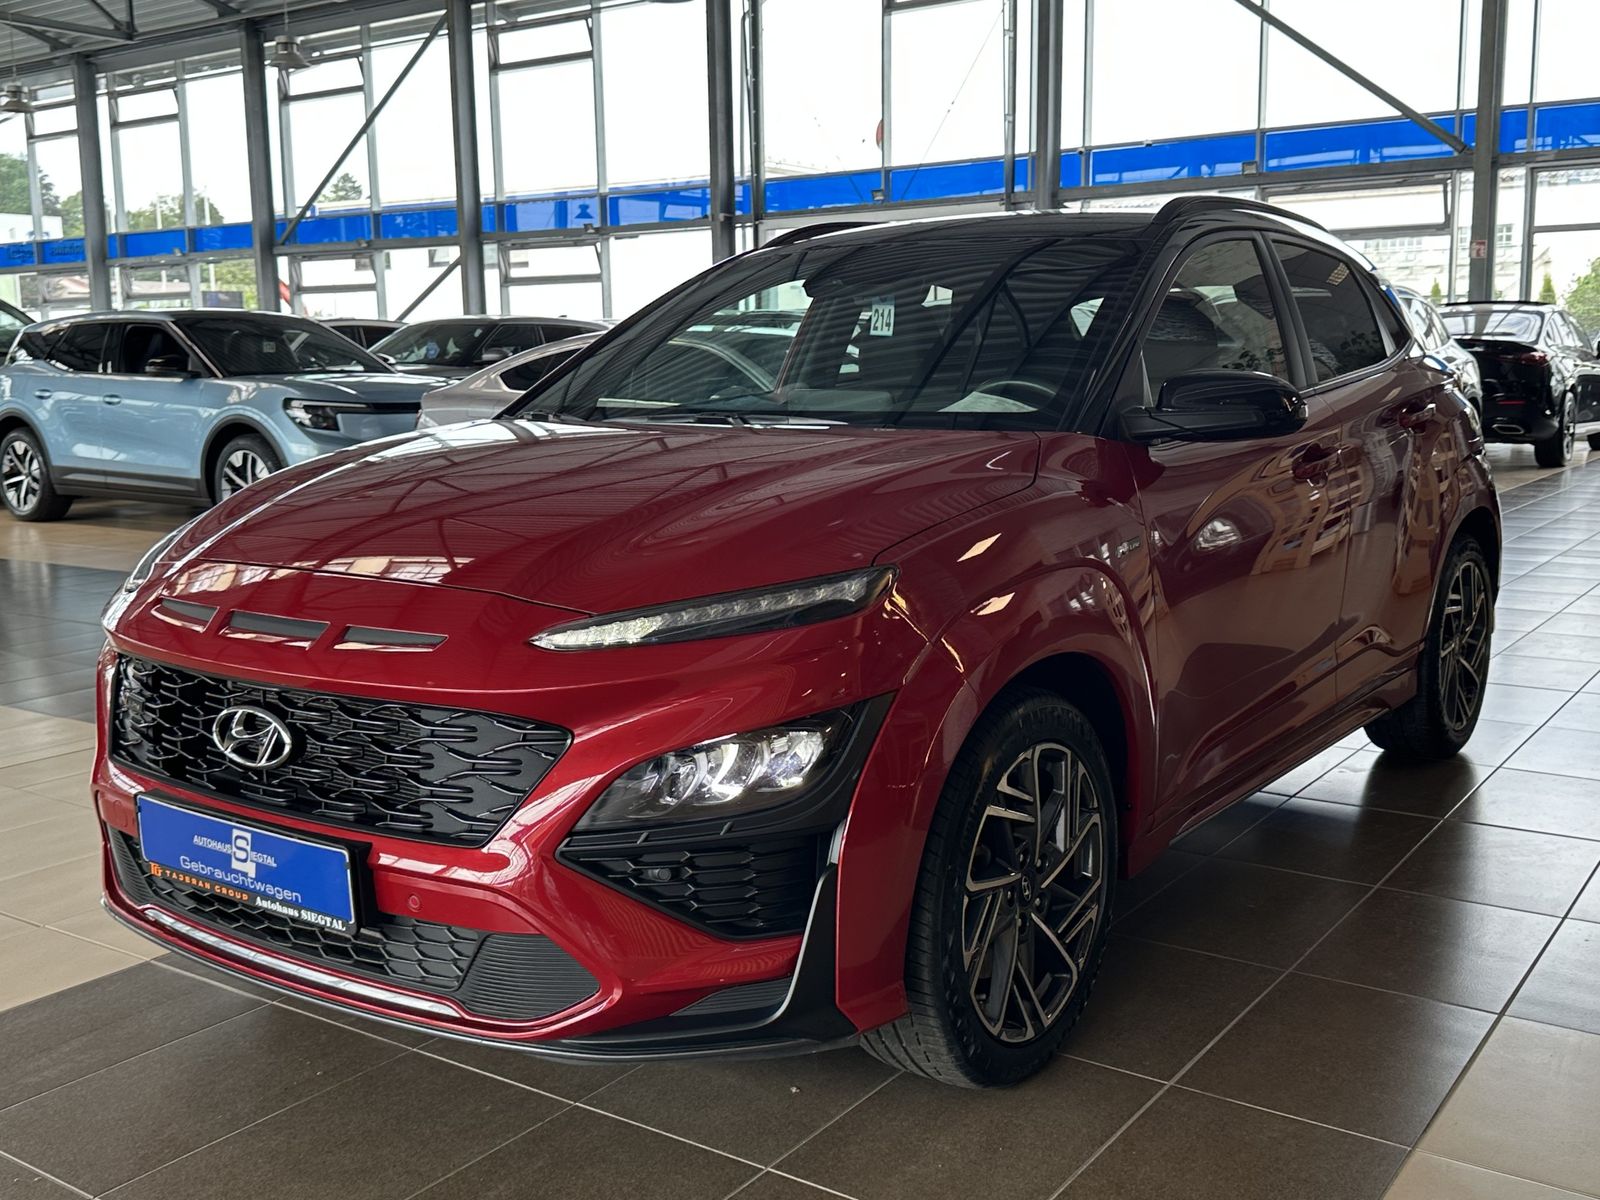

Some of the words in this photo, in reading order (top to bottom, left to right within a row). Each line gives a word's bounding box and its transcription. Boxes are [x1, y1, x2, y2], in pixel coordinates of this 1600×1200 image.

[872, 308, 892, 332] 214
[193, 835, 232, 854] AUTOHAUS
[180, 855, 302, 904] Gebrauchtwagen
[214, 885, 249, 901] GROUP
[255, 896, 299, 918] Autohaus
[300, 910, 346, 931] SIEGTAL
